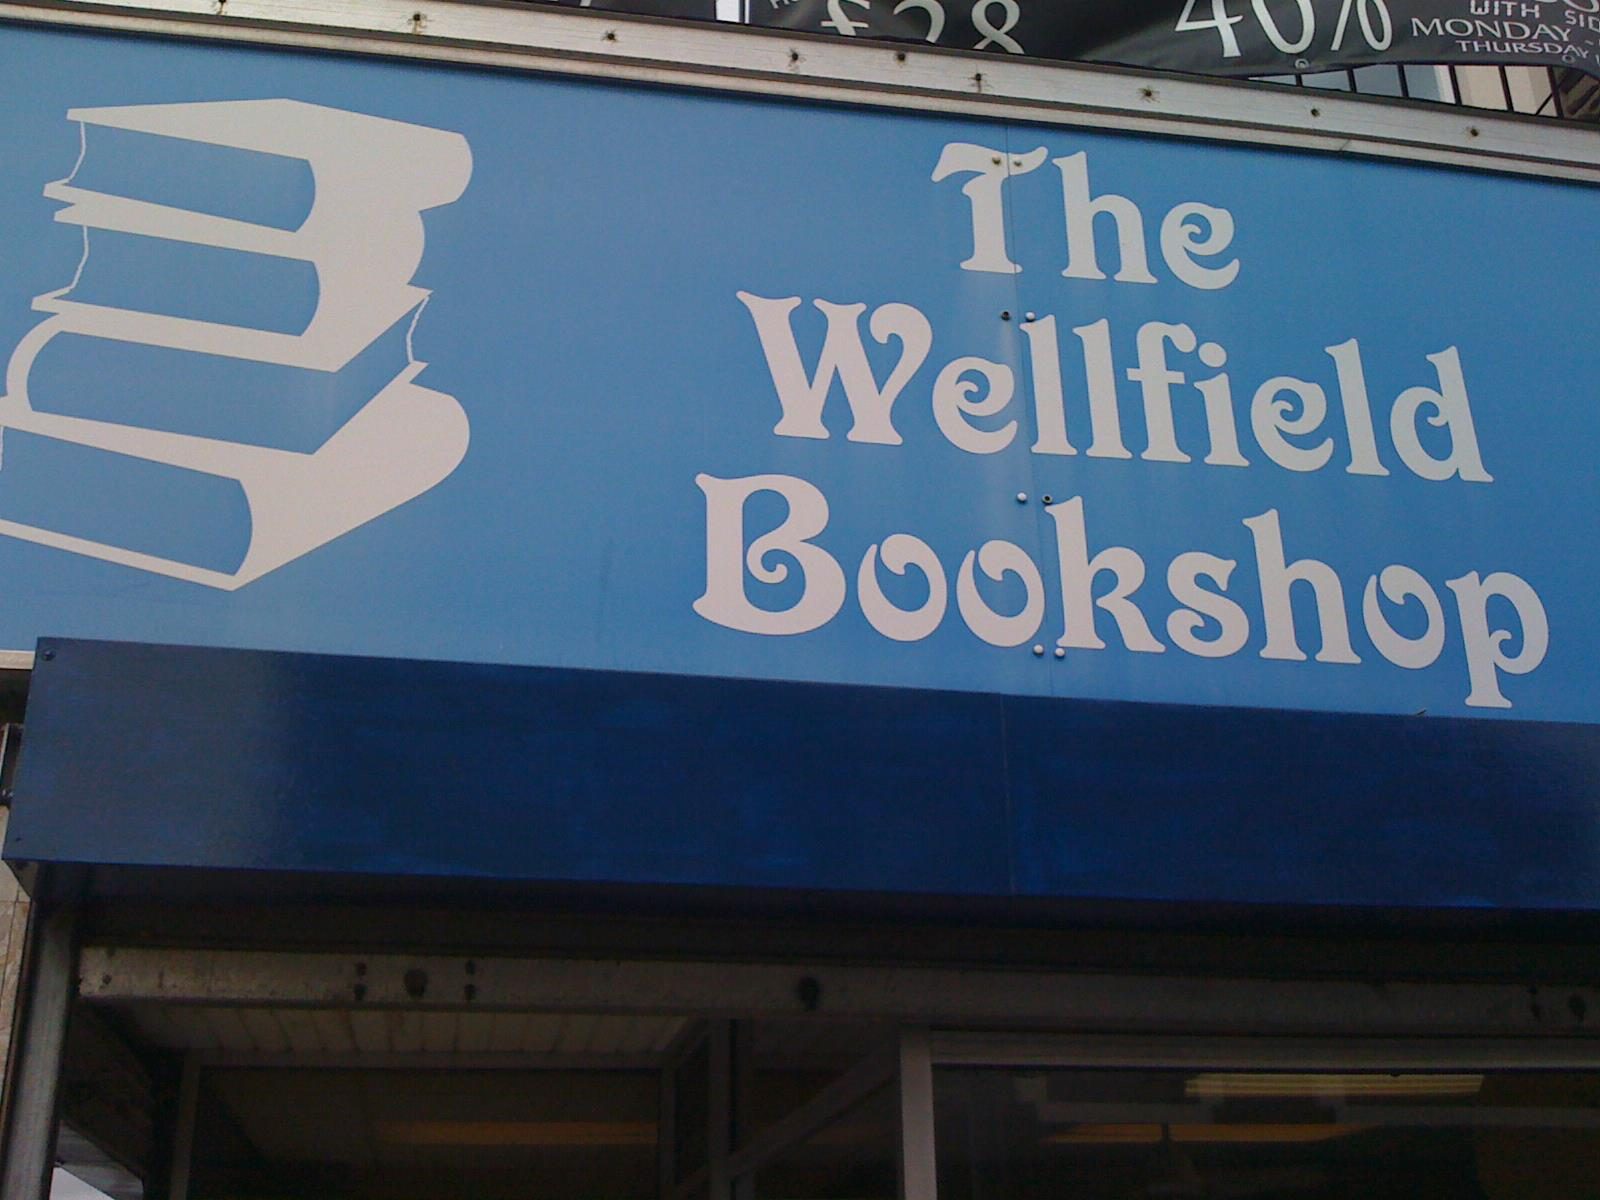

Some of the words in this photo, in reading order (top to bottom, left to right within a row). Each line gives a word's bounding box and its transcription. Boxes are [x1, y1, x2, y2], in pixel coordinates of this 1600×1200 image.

[1411, 17, 1571, 42] MONDAY
[1455, 40, 1589, 59] THURSDAY
[1470, 0, 1540, 18] WITH
[932, 141, 1241, 291] The
[736, 290, 1494, 484] Wellfield
[692, 472, 1549, 708] Bookshop
